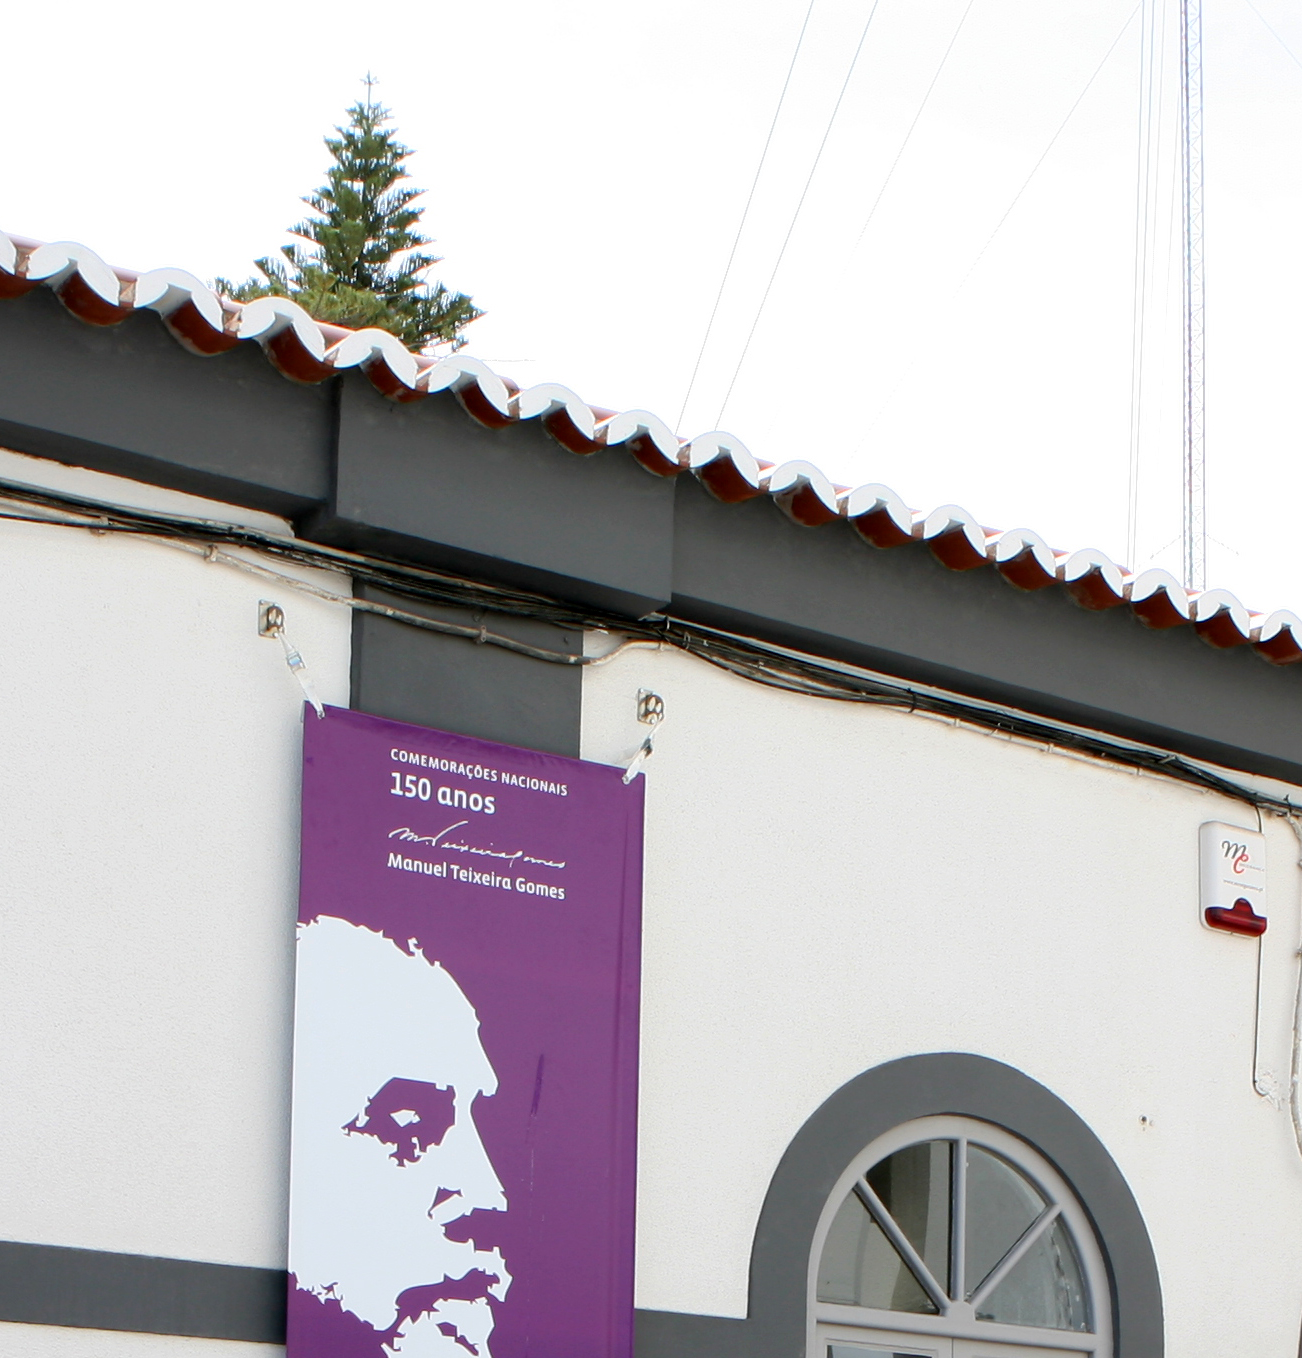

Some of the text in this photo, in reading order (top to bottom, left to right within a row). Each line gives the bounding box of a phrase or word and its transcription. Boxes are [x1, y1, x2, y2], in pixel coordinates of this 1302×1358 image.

[390, 748, 568, 797] COMEMORAÇÕES NACIONAIS
[390, 771, 497, 815] 150 anos
[387, 852, 566, 900] Manuel Teixeira Gomes
